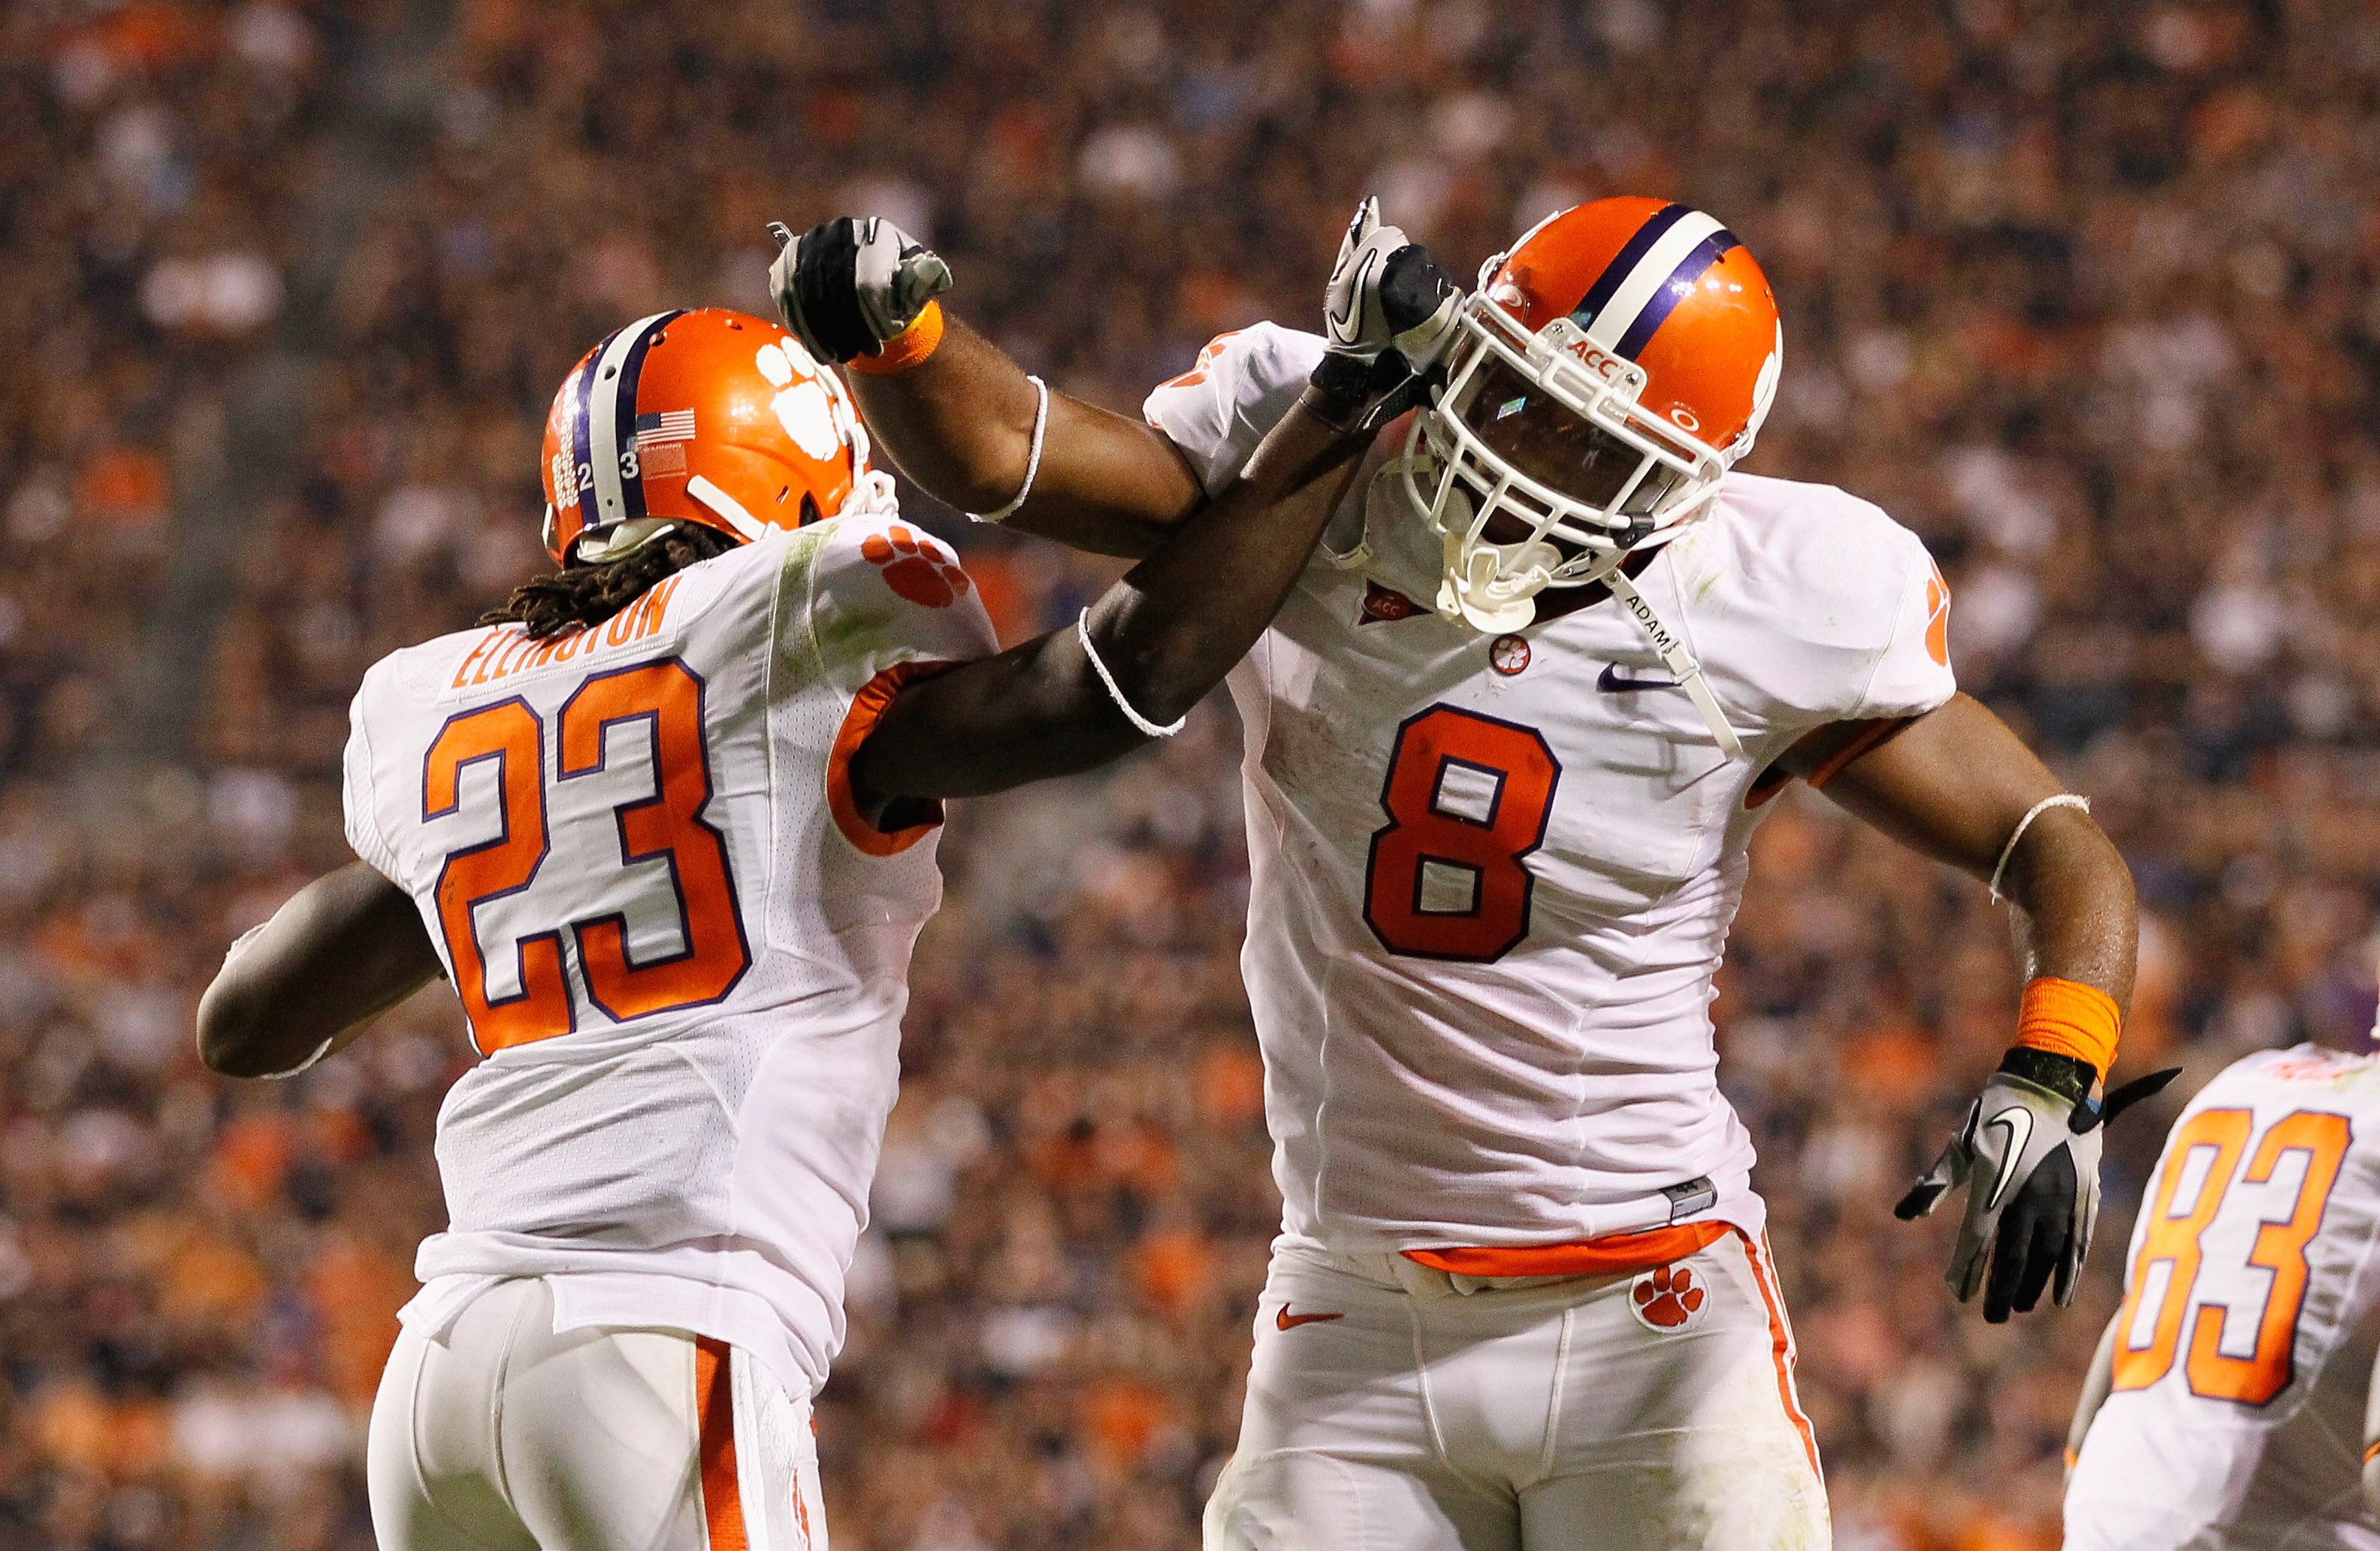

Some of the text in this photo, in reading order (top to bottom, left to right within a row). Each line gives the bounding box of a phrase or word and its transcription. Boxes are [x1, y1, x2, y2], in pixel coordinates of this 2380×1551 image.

[1567, 340, 1618, 378] ACC
[578, 462, 593, 491] 2
[620, 452, 639, 479] 3
[1373, 600, 1400, 615] ACC
[421, 657, 752, 1057] 23
[1362, 701, 1563, 964] 8
[2112, 1108, 2353, 1407] 83
